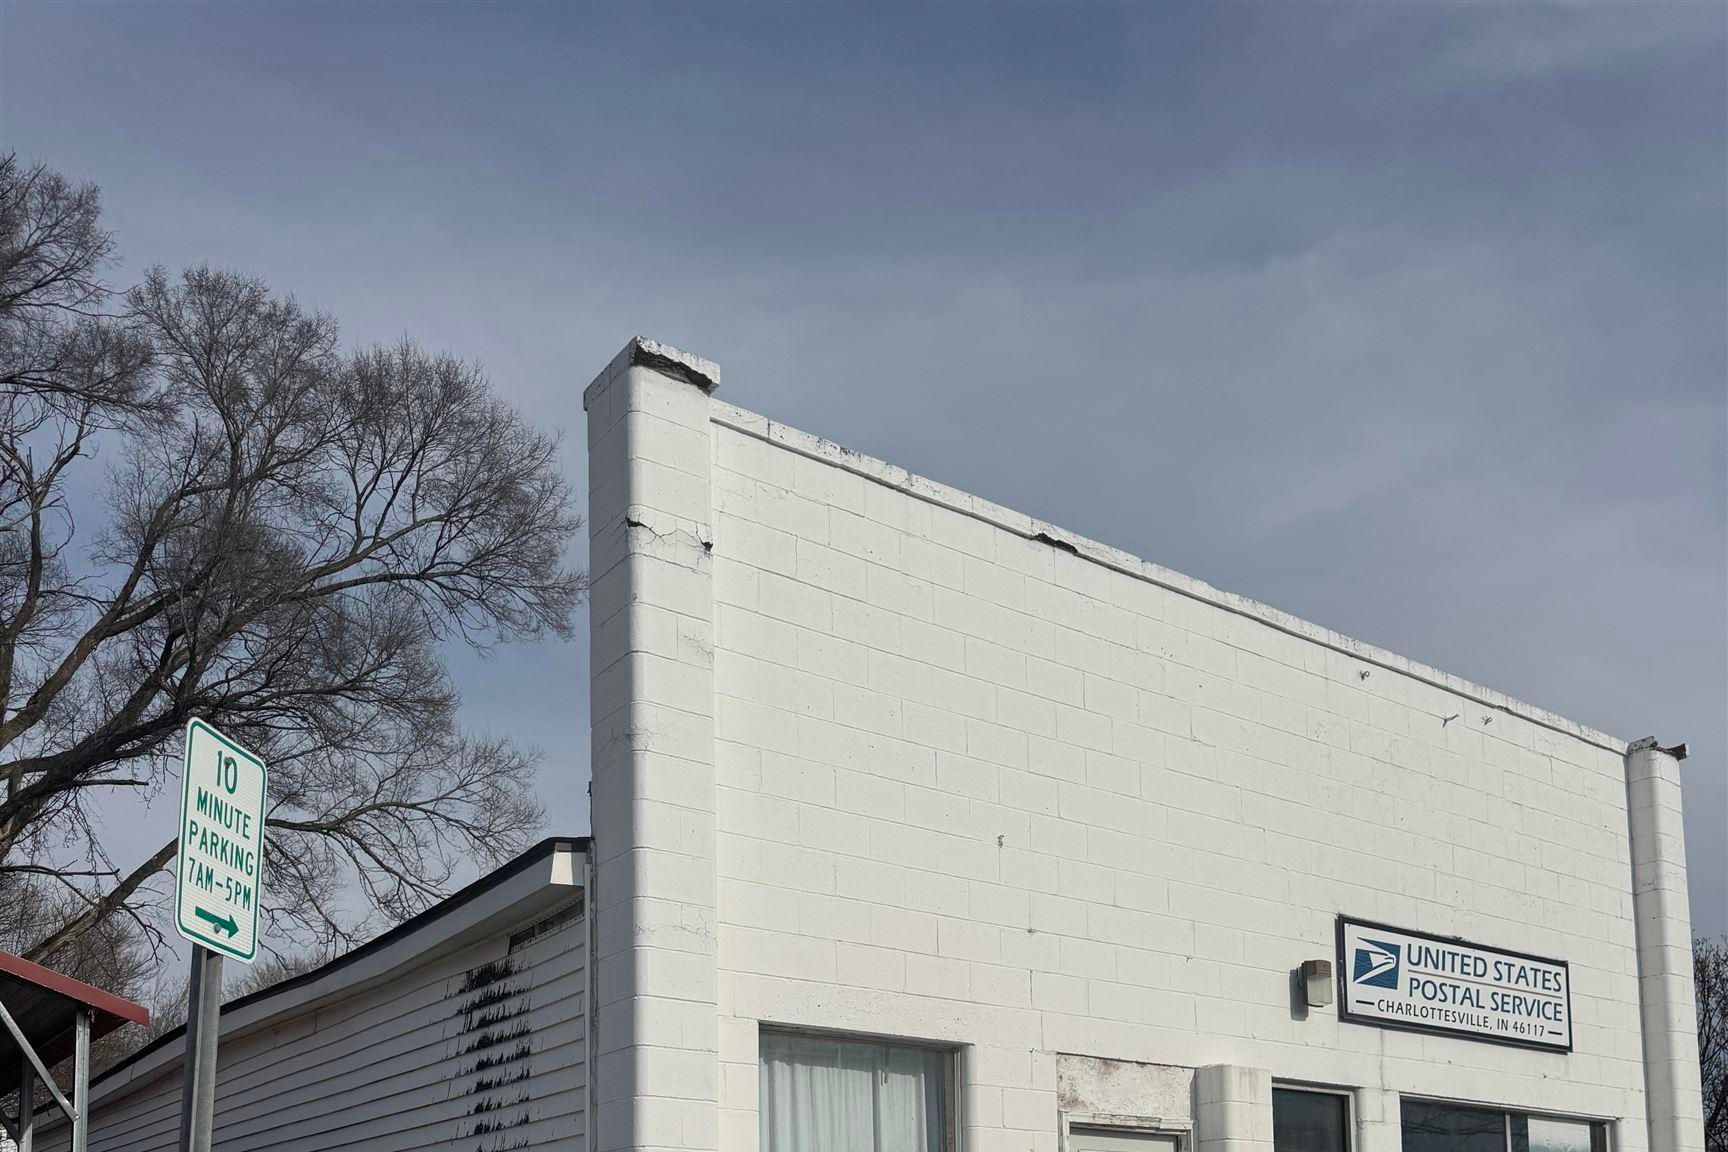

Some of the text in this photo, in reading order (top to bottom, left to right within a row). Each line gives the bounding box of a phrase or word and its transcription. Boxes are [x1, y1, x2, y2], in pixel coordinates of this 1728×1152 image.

[217, 750, 238, 794] 10
[196, 786, 251, 840] MINUTE
[189, 819, 254, 877] PARKING
[188, 856, 251, 911] 7AM-5PM
[1406, 943, 1562, 992] UNITED STATES
[1377, 999, 1545, 1037] CHARLOTTESVILLE, IN 46117
[1409, 977, 1563, 1022] POSTAL SERVICE
